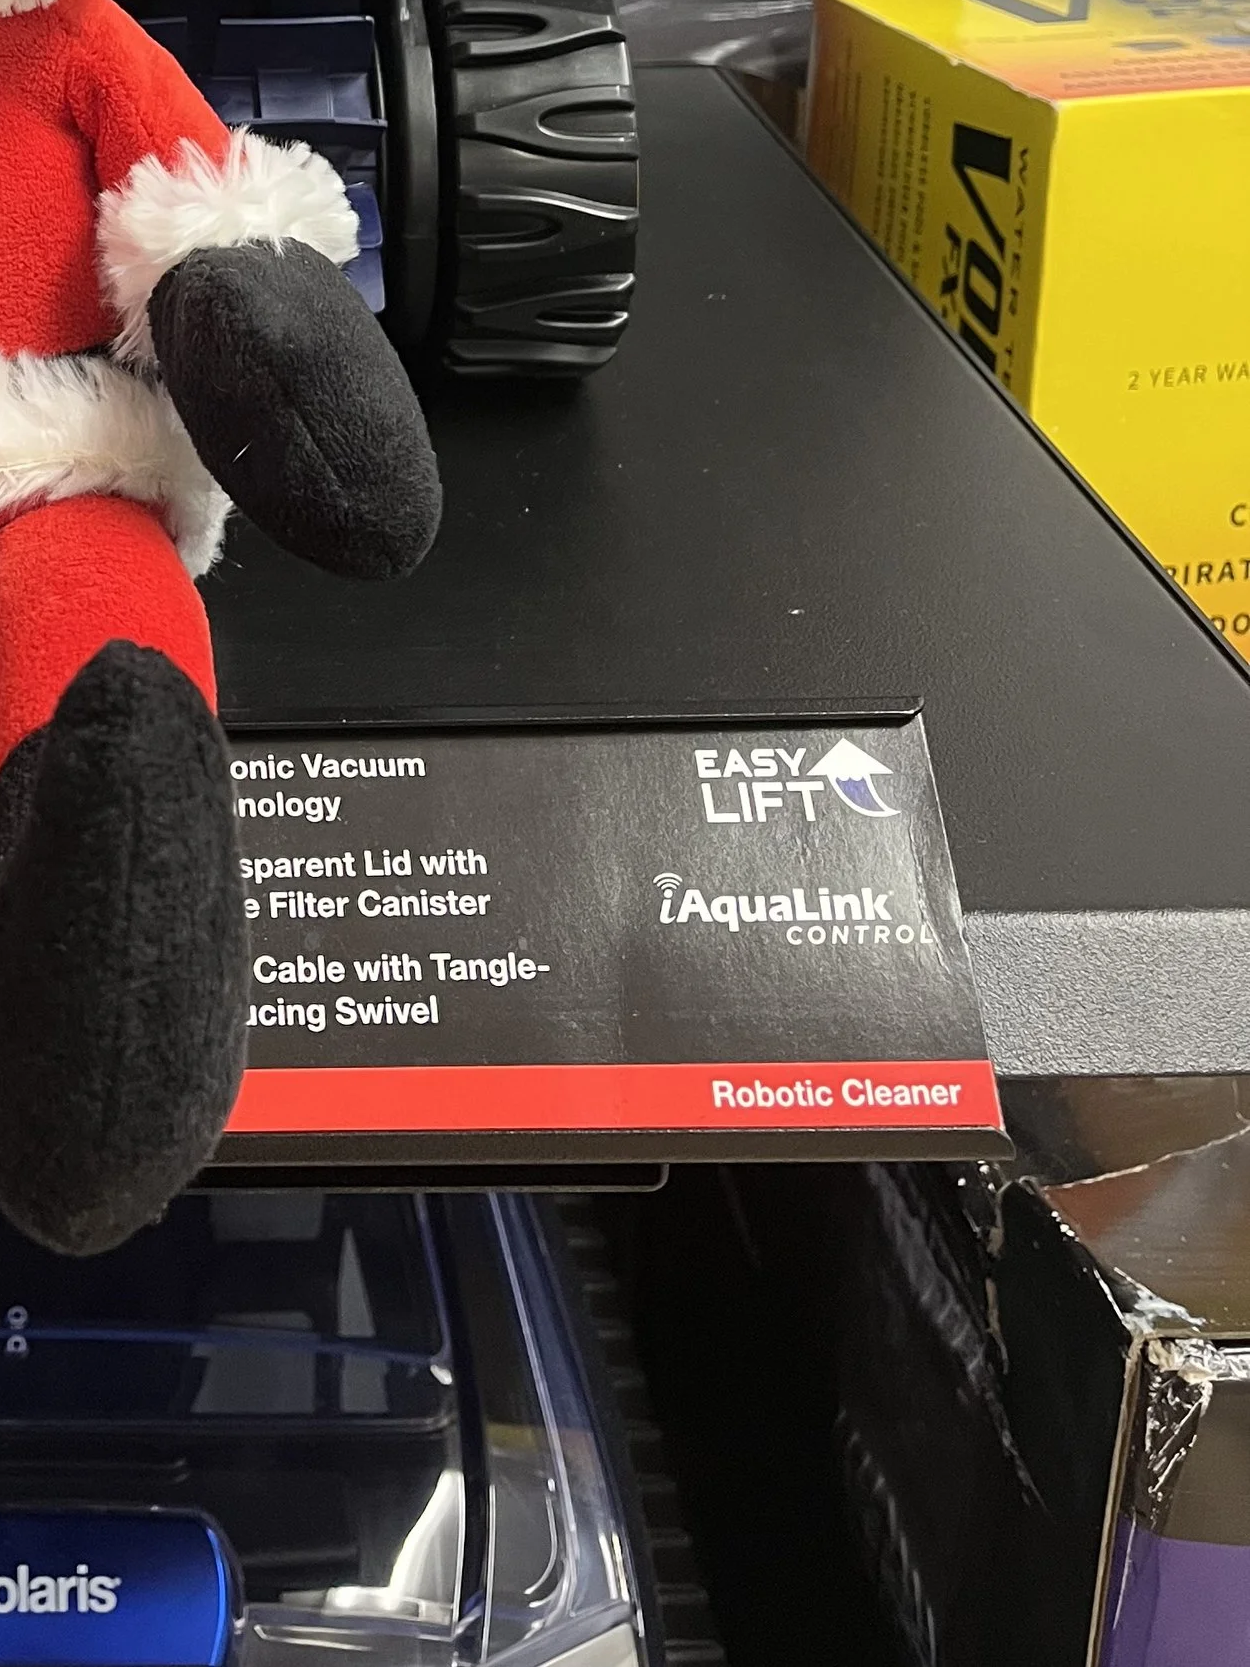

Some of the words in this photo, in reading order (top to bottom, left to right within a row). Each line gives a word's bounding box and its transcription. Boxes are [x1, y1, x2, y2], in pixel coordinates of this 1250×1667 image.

[1007, 147, 1030, 316] WATER
[1128, 370, 1140, 390] 2
[1149, 364, 1208, 389] YEAR
[300, 752, 427, 780] Vacuum
[695, 748, 806, 778] EASY
[233, 790, 342, 825] nology
[701, 781, 824, 823] LIFT
[363, 849, 412, 878] Lid
[419, 847, 489, 877] with
[268, 890, 350, 920] Filter
[356, 888, 492, 918] Canister
[659, 886, 893, 932] iAquaLink
[786, 924, 934, 946] CONTROL
[253, 954, 346, 984] Cable
[353, 952, 423, 983] with
[429, 950, 551, 988] Tangle-
[335, 993, 440, 1026] Swivel
[712, 1078, 834, 1109] Robotic
[841, 1077, 963, 1108] Cleaner
